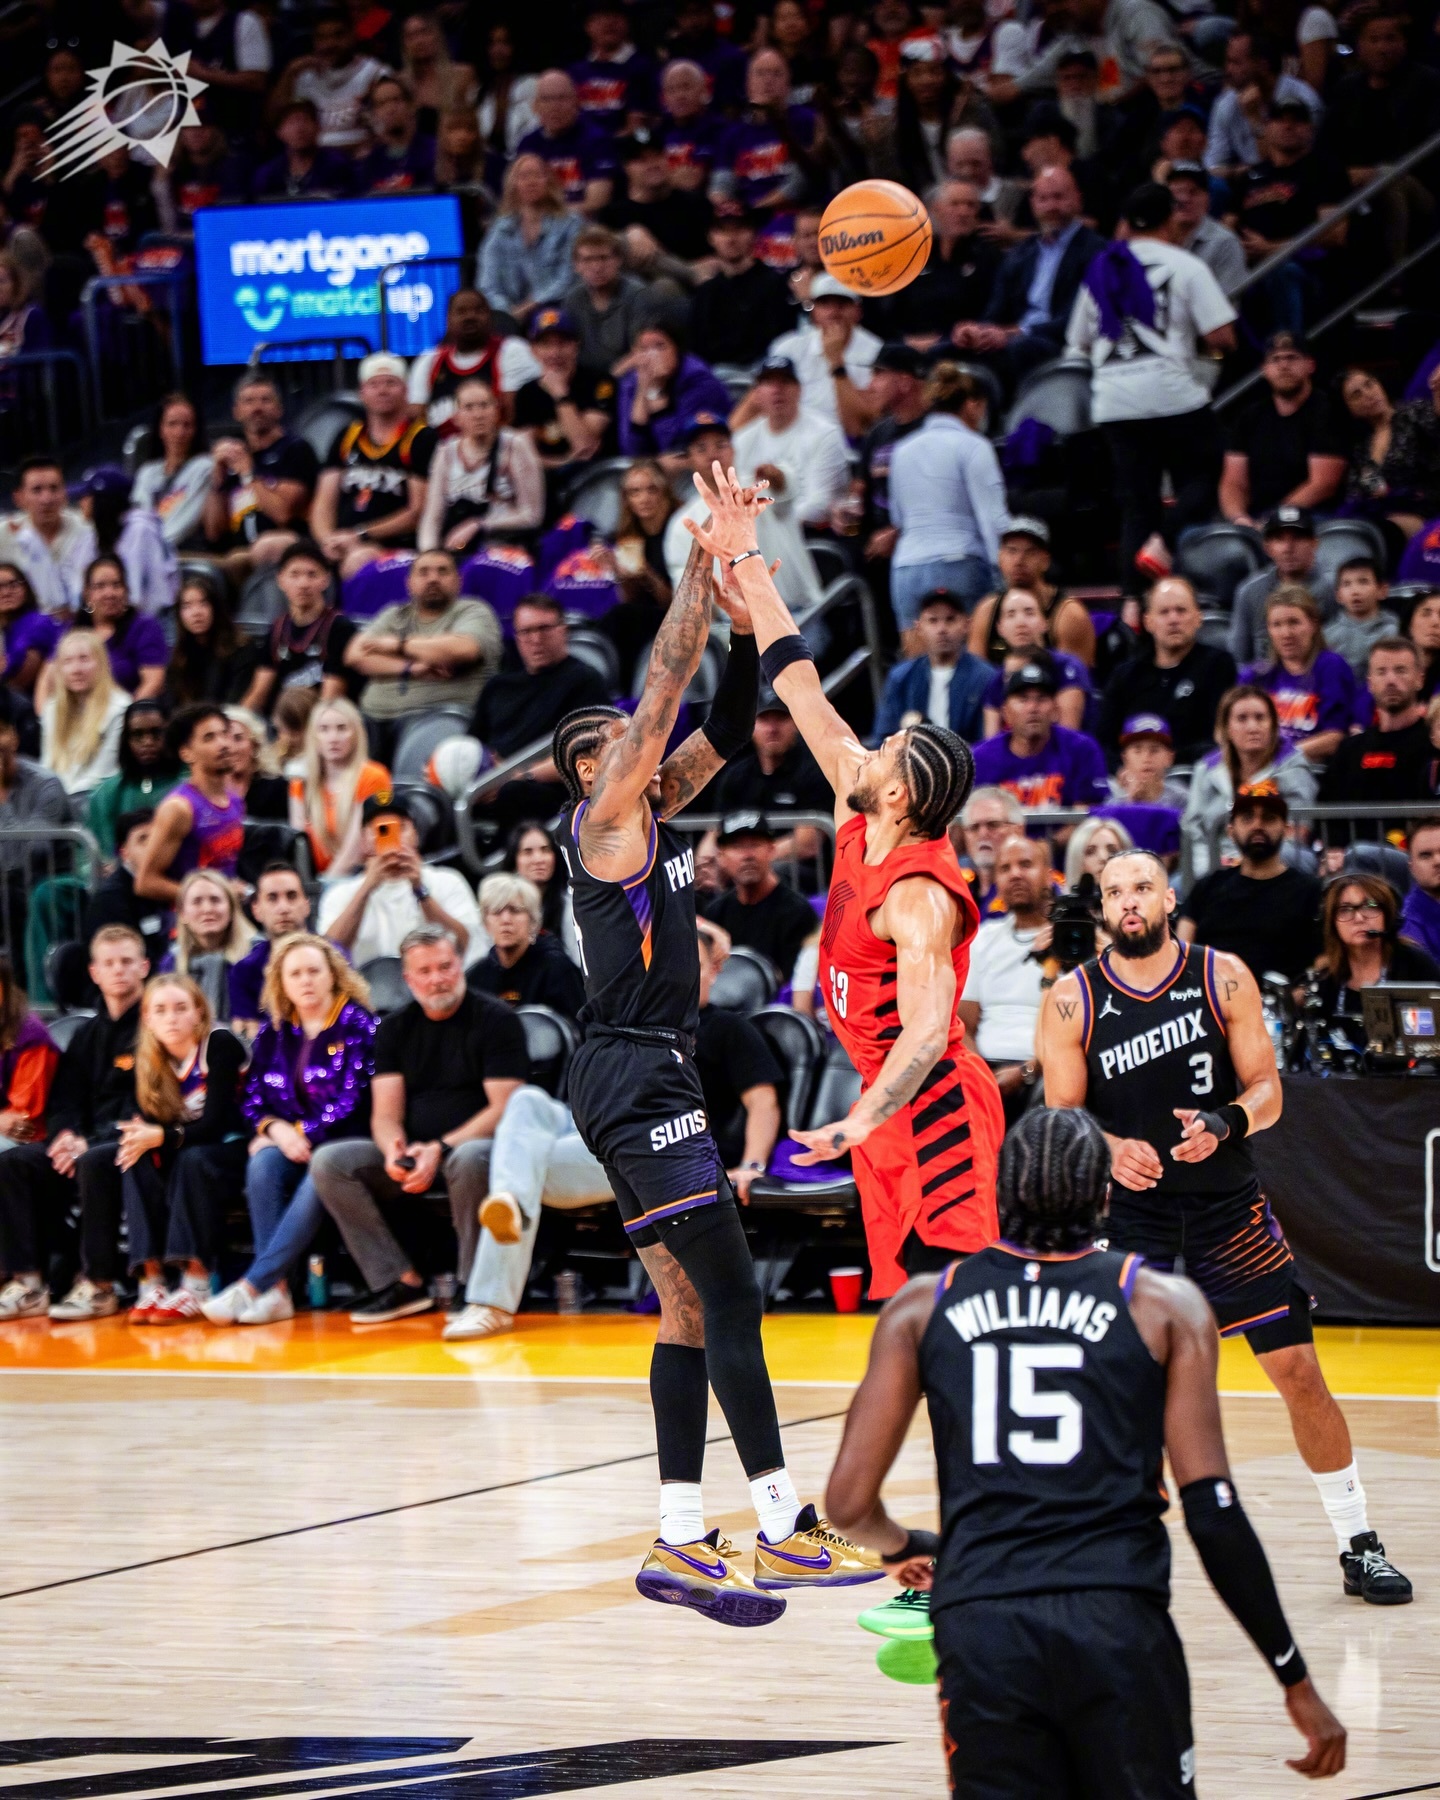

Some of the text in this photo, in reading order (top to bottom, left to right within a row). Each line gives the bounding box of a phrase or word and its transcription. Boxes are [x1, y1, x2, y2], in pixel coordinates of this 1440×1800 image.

[820, 230, 885, 256] Wilson
[387, 283, 434, 322] up
[1169, 987, 1203, 1002] PayPal
[1098, 1008, 1208, 1080] PHOENIX
[1188, 1052, 1214, 1095] 3
[650, 1109, 707, 1152] SUNS
[945, 1285, 1118, 1343] WILLIAMS
[971, 1342, 1085, 1465] 15
